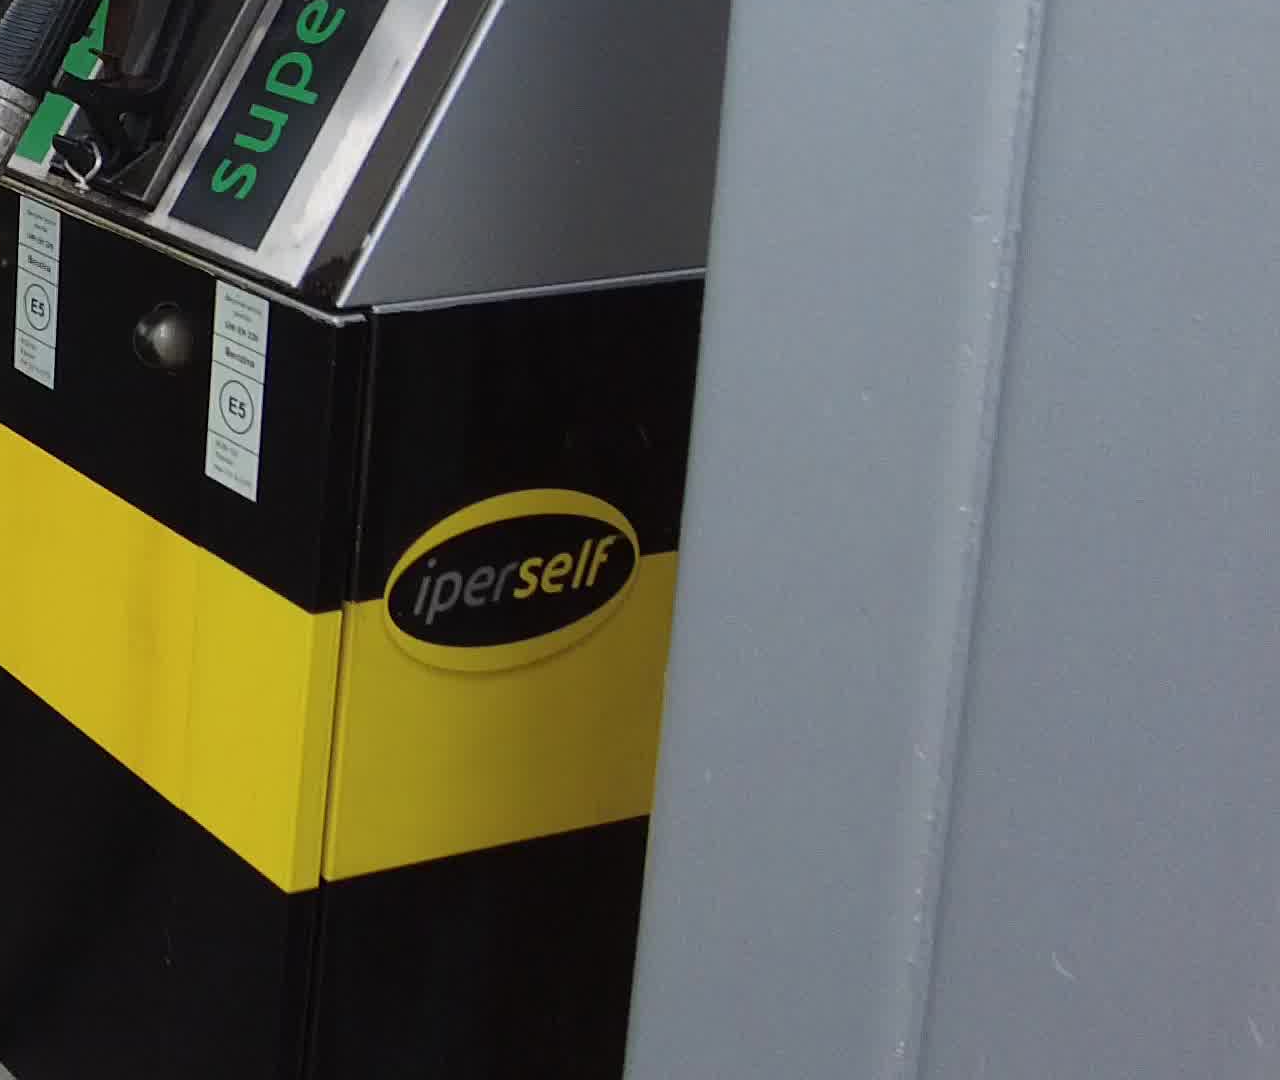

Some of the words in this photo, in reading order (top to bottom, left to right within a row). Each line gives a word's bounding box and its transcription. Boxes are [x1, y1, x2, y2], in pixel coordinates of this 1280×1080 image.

[30, 297, 45, 317] E5
[224, 345, 255, 369] Benzina
[228, 396, 247, 419] E5
[414, 535, 618, 625] iperself
